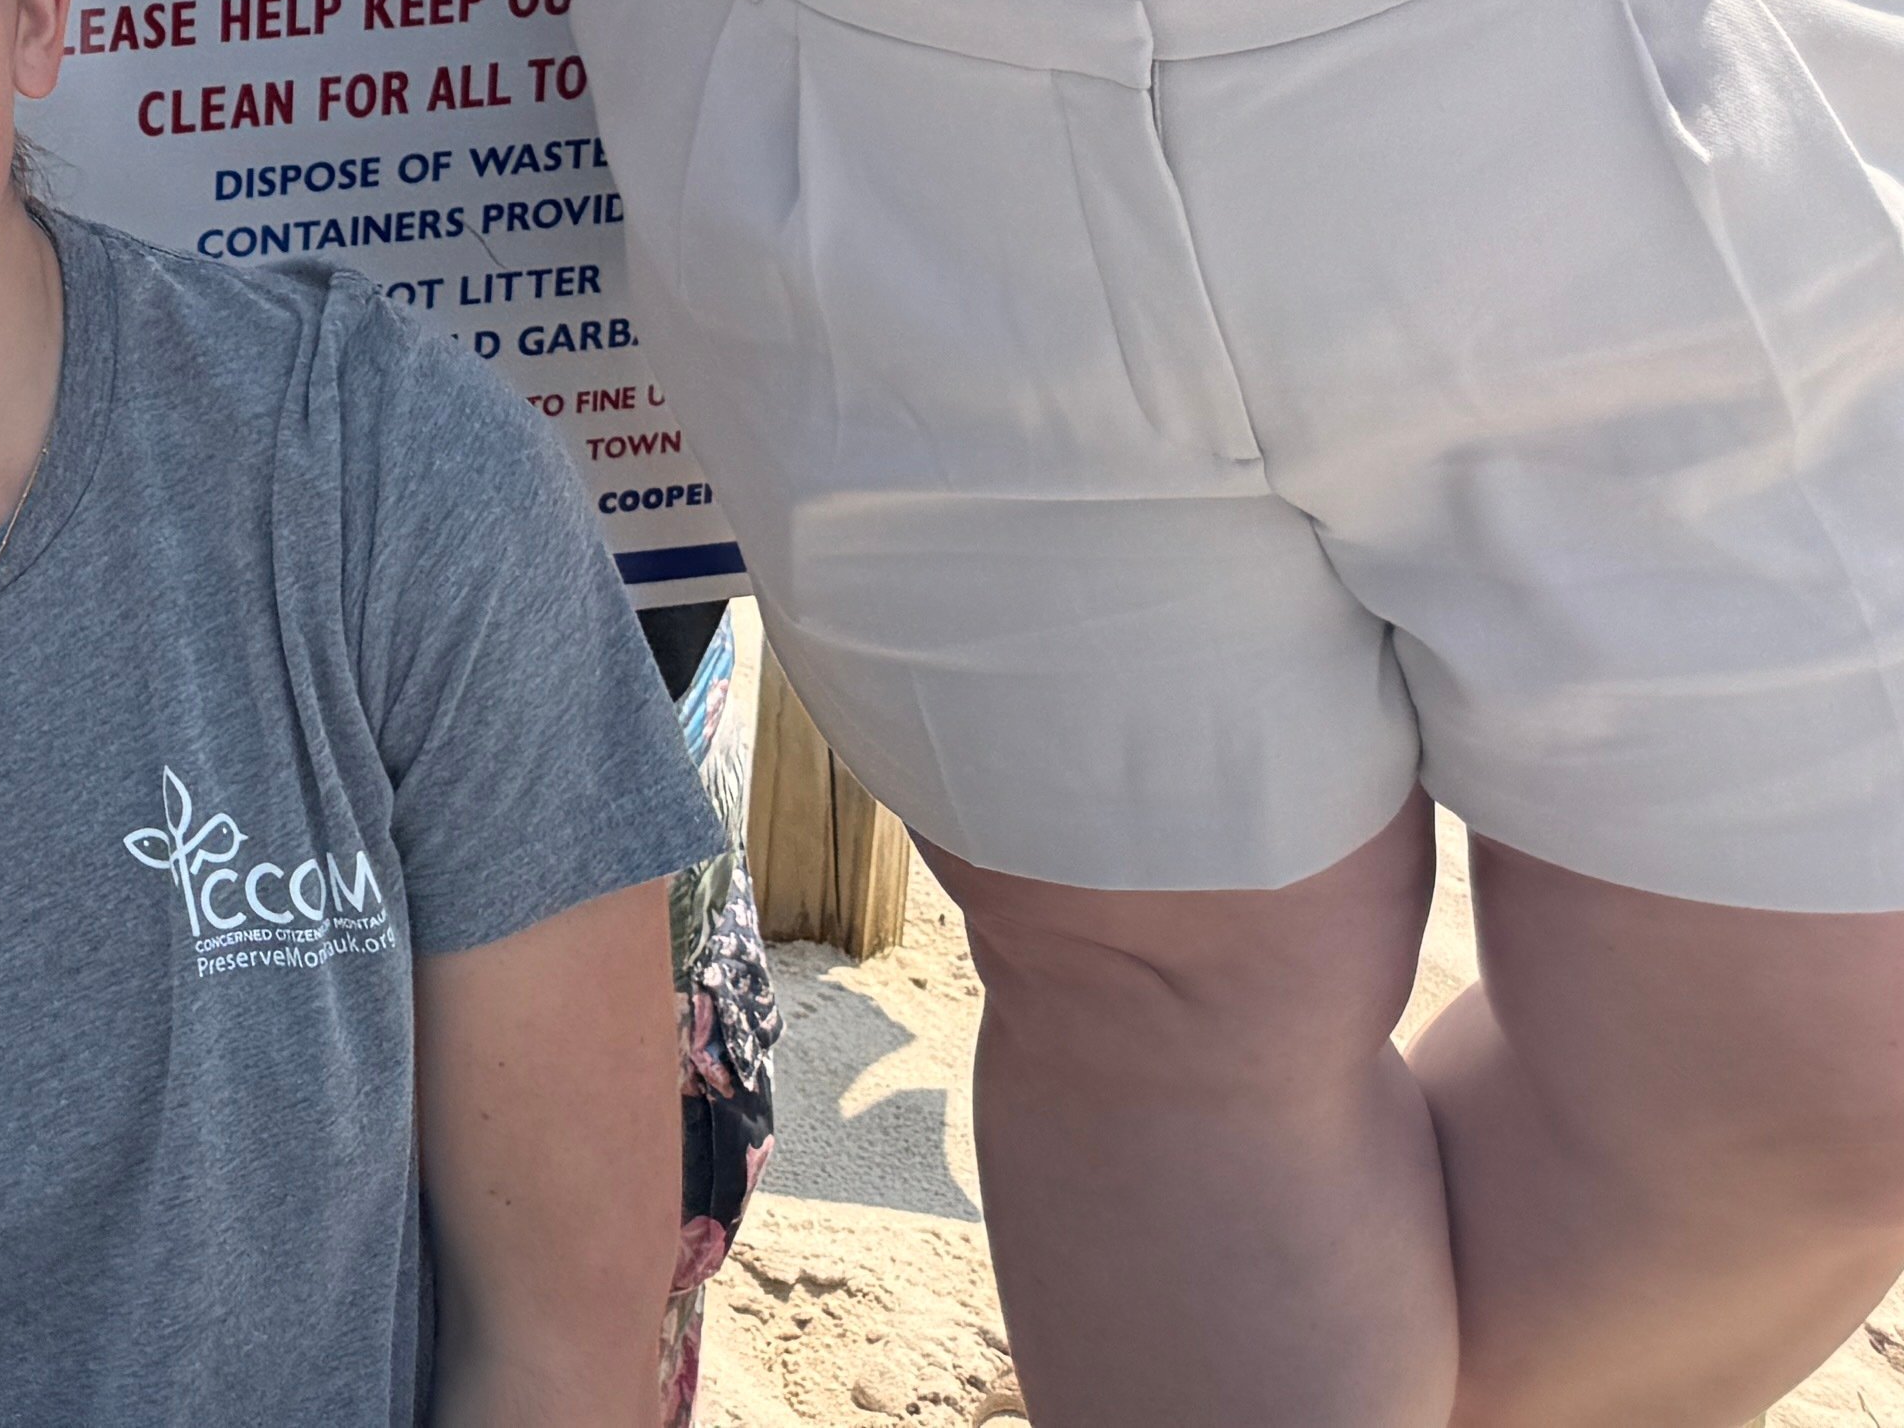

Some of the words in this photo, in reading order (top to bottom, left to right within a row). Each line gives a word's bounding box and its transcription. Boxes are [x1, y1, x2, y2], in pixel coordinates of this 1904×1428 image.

[139, 80, 293, 136] CLEAN
[319, 71, 408, 121] FOR
[427, 62, 511, 111] ALL
[528, 54, 586, 102] TO
[216, 157, 380, 200] DISPOSE
[399, 151, 452, 184] OF
[197, 206, 464, 258] CONTAINERS
[460, 265, 601, 305] LITTER
[577, 387, 635, 413] FINE
[587, 431, 682, 460] TOWN
[201, 851, 382, 930] CCOM
